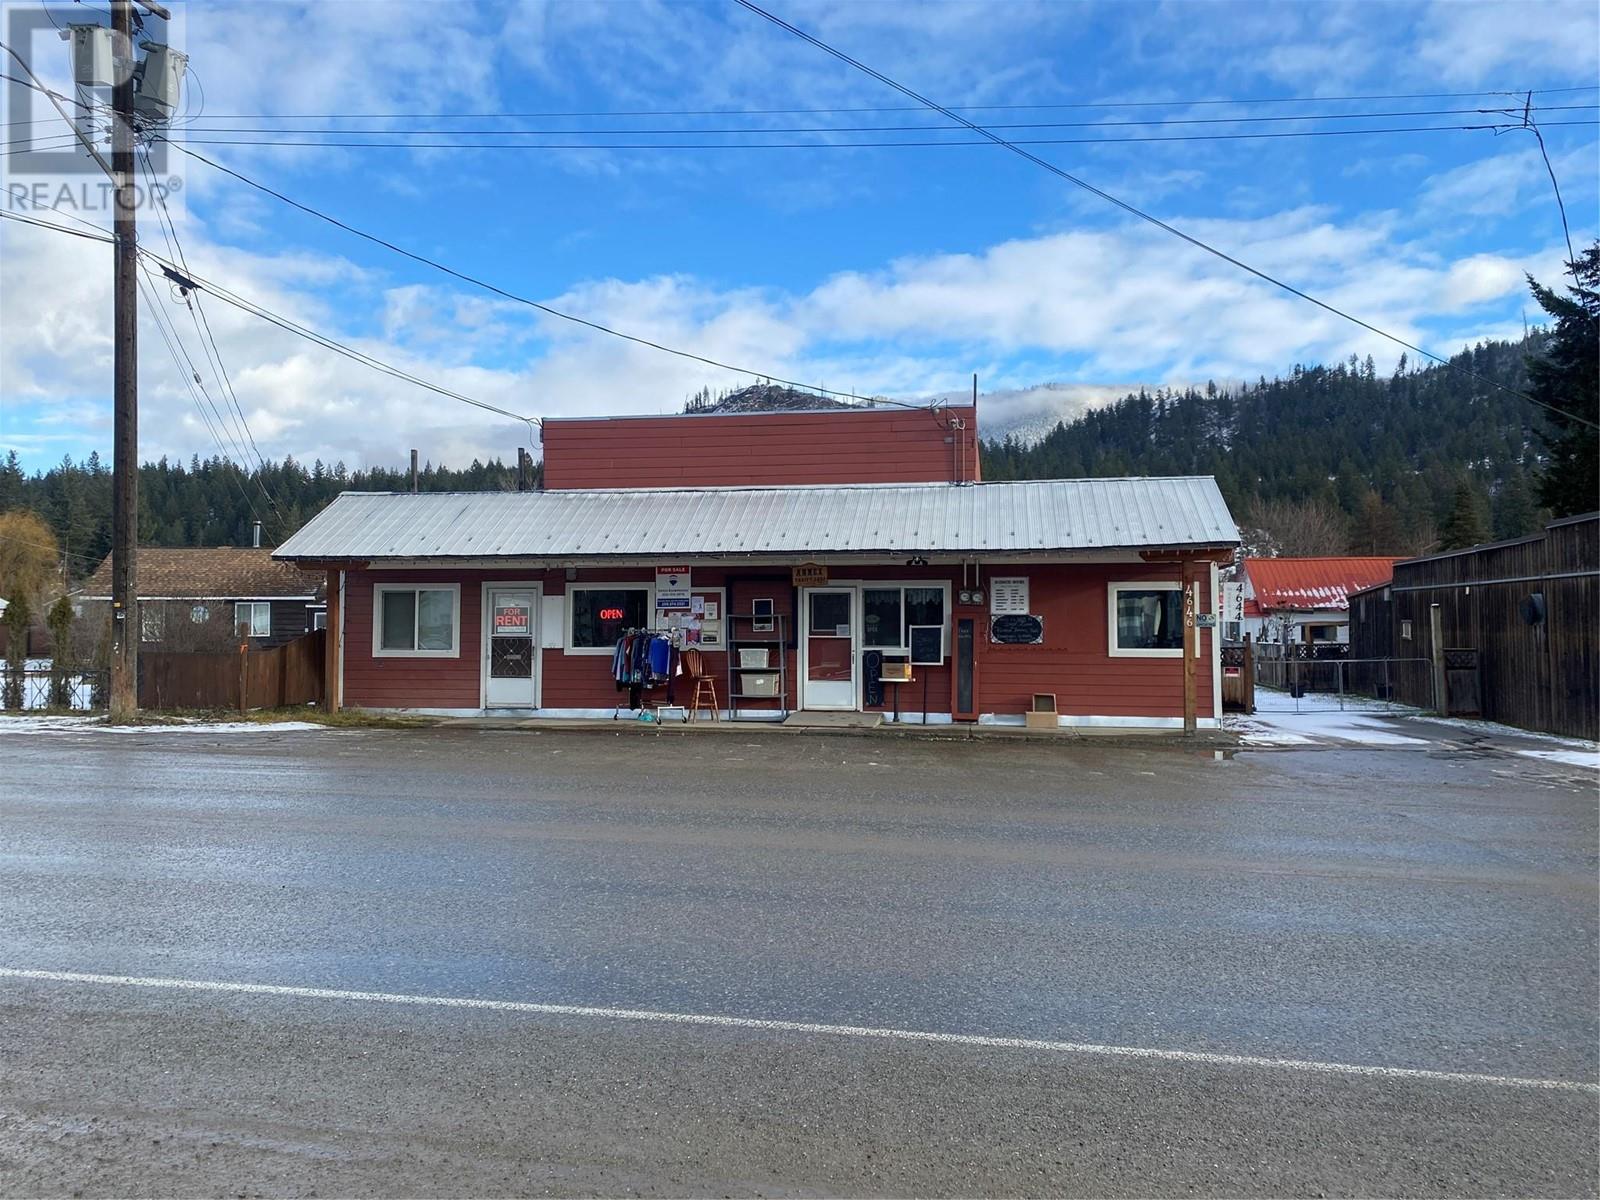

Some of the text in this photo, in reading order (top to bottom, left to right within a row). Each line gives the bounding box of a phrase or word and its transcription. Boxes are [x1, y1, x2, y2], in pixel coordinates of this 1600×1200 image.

[1185, 584, 1194, 627] 4646
[1234, 583, 1244, 621] 4644
[503, 608, 521, 616] FOR
[600, 609, 623, 620] OPEN
[496, 615, 528, 626] RENT
[1196, 614, 1207, 622] NO
[866, 652, 880, 705] OPEN
